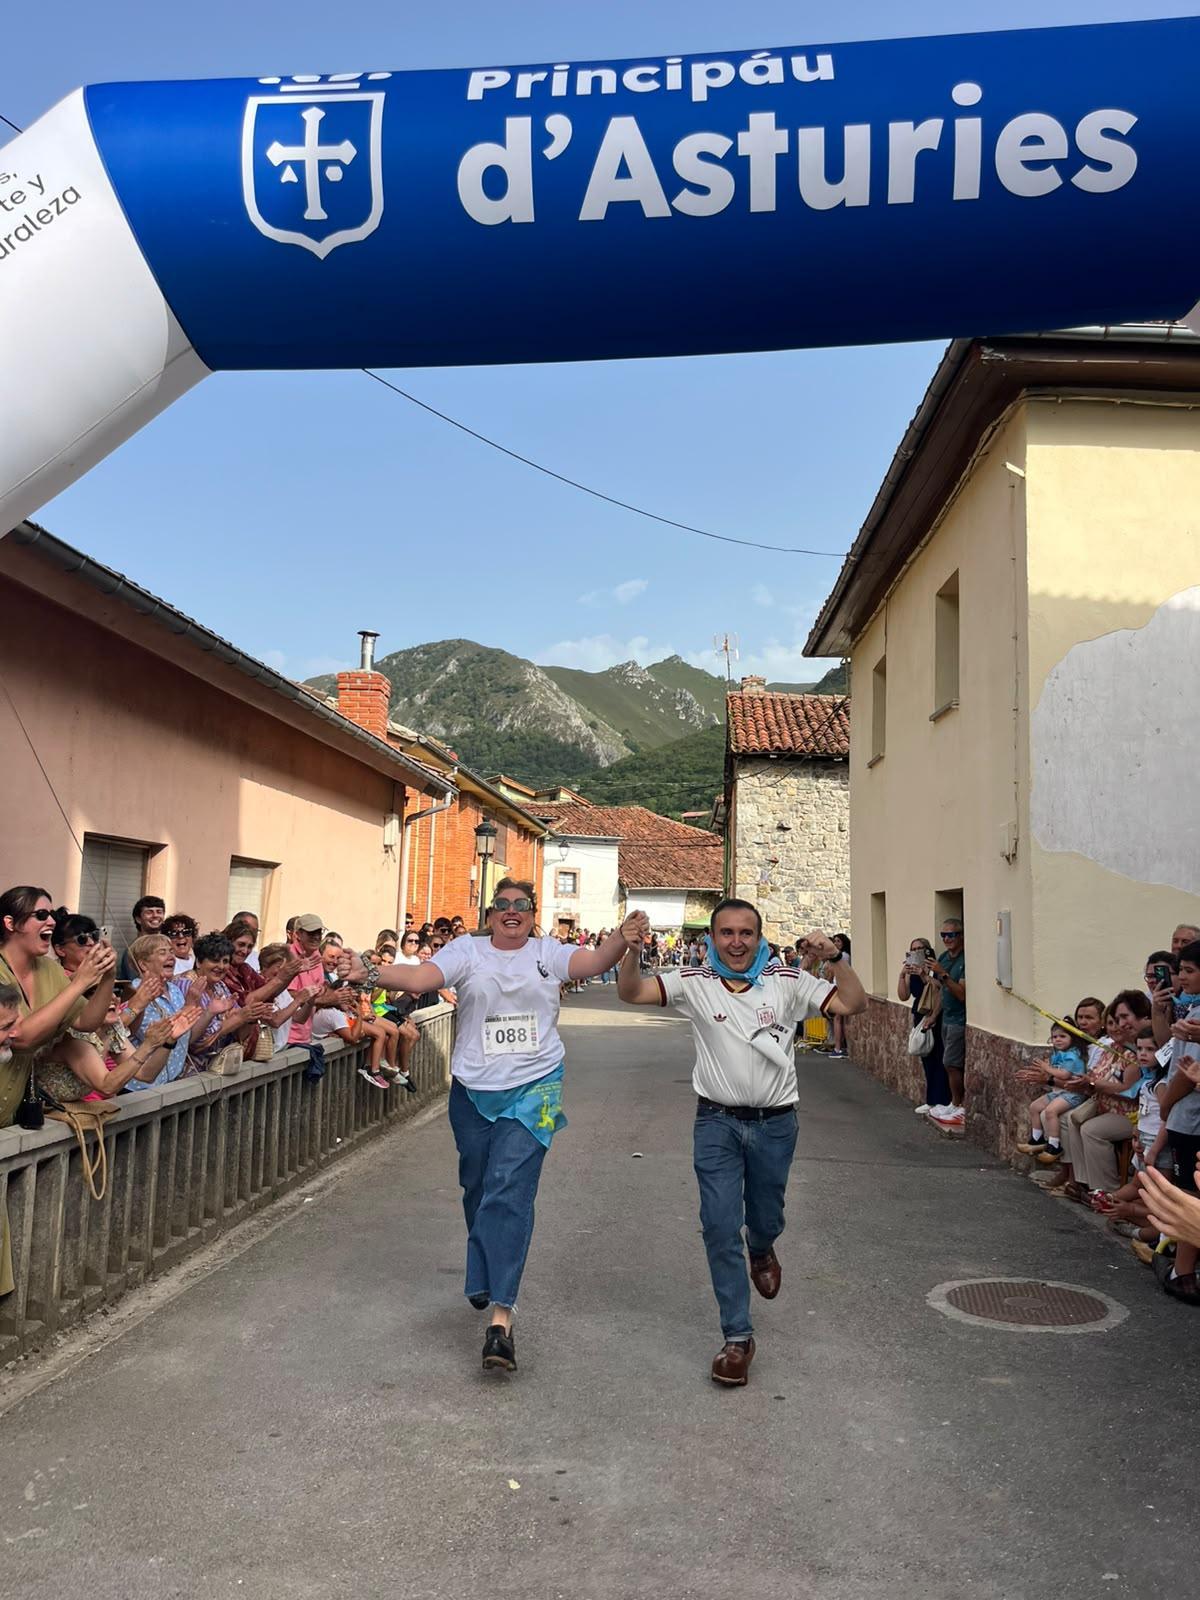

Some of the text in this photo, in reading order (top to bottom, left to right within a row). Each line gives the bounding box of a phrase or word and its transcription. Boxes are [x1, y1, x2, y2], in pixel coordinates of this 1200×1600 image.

[467, 51, 835, 103] Principáu
[457, 83, 1138, 226] d’Asturies
[0, 174, 45, 212] te y
[495, 1027, 528, 1044] 088
